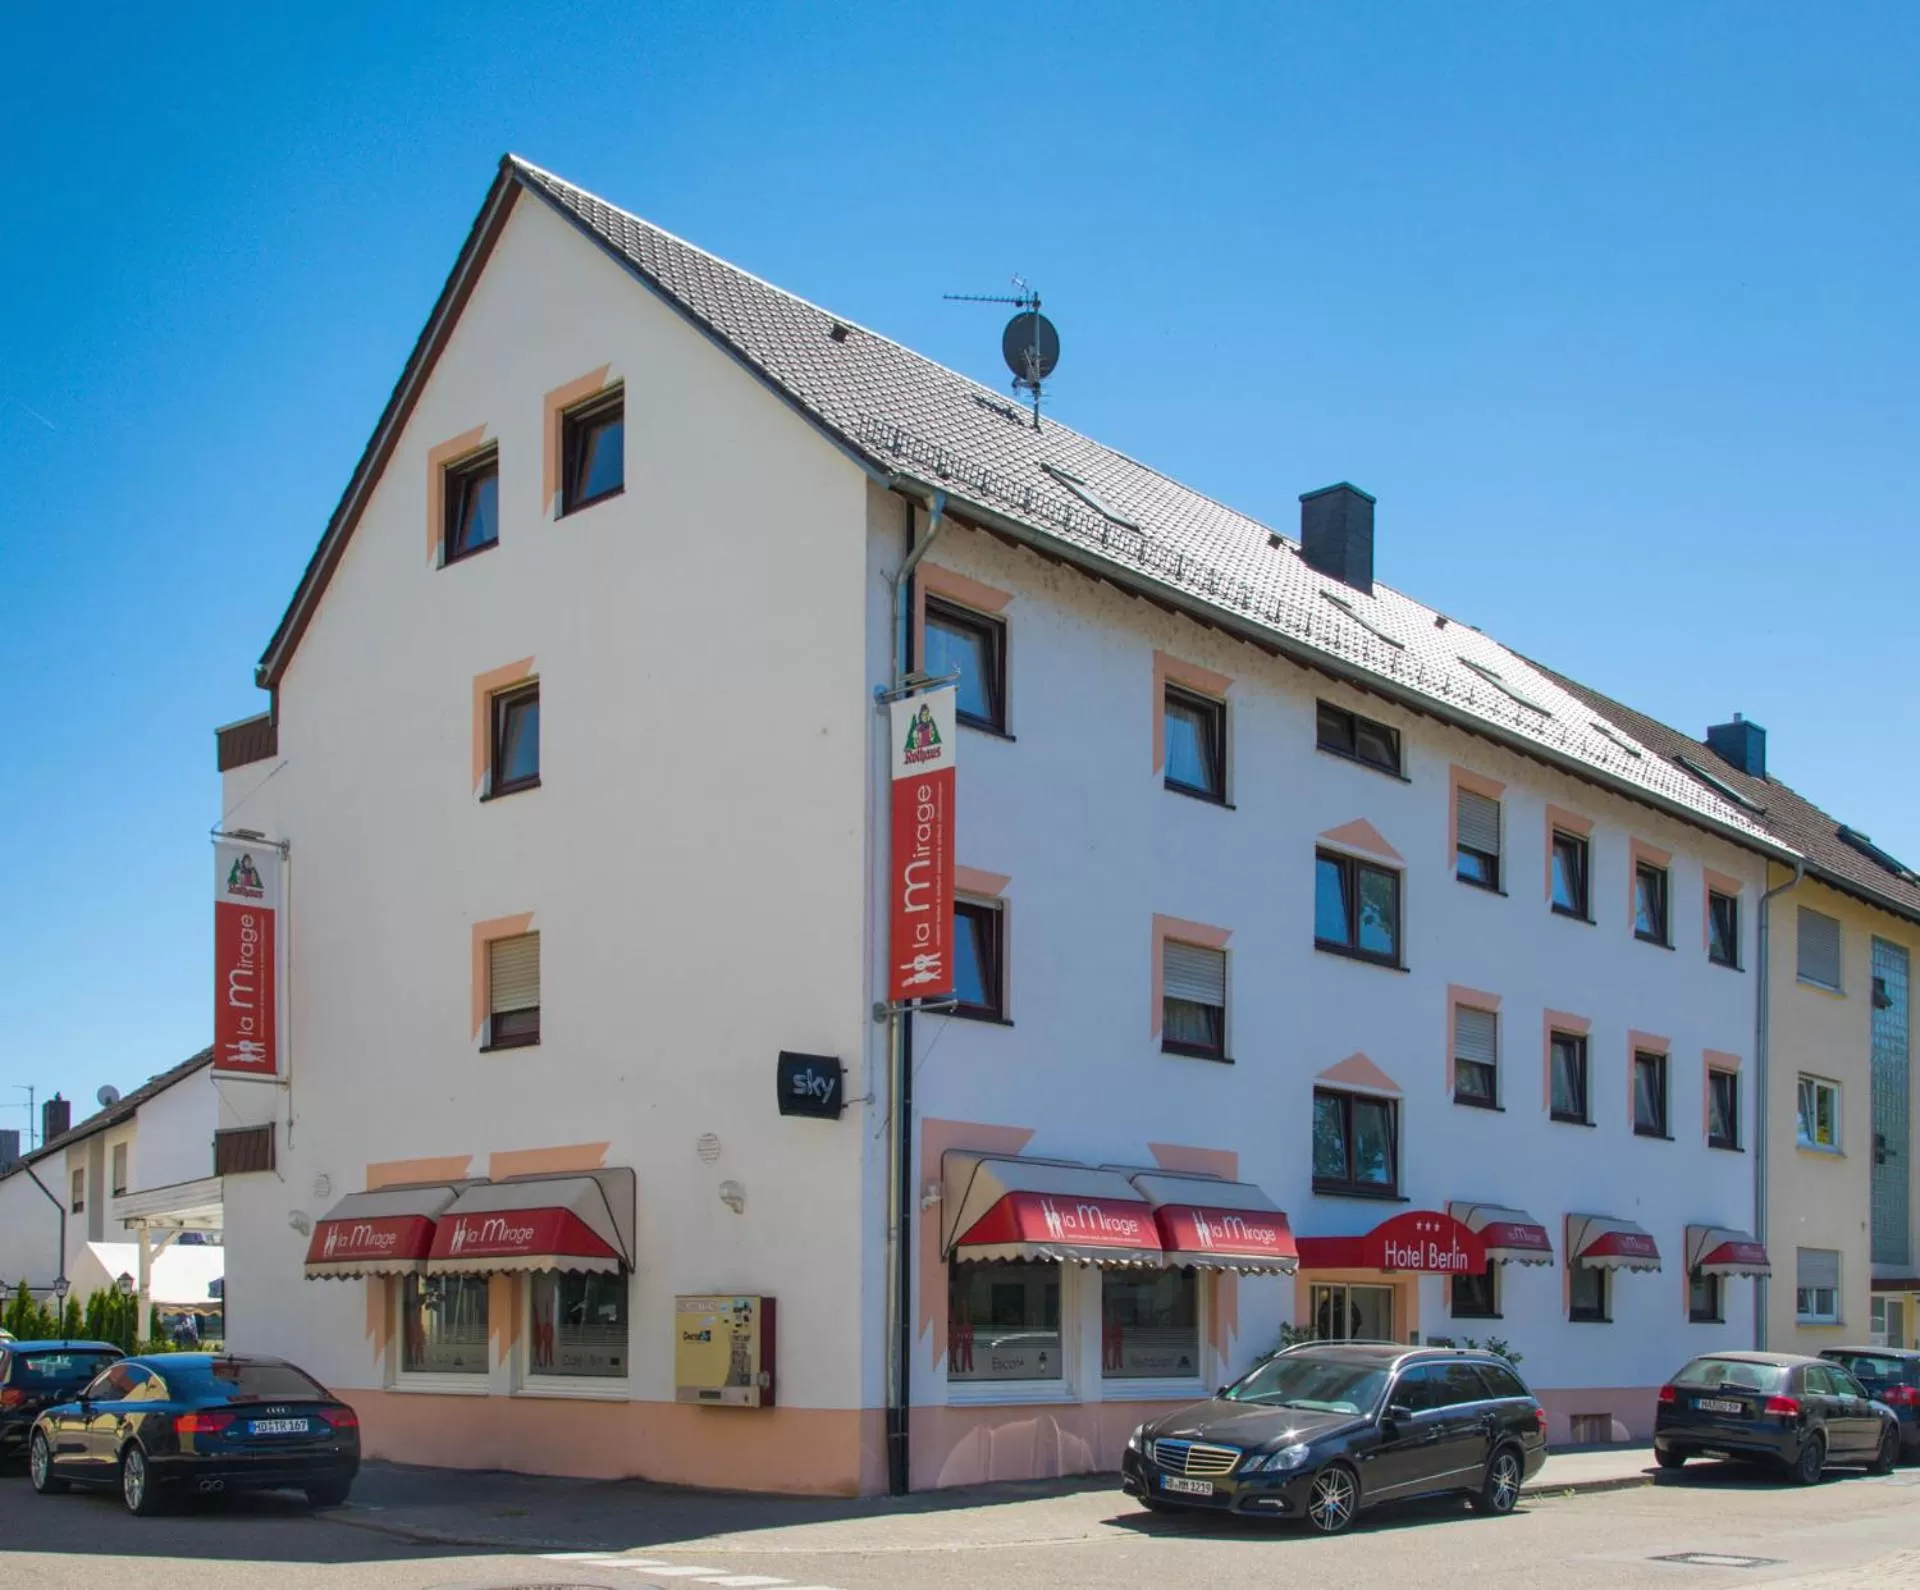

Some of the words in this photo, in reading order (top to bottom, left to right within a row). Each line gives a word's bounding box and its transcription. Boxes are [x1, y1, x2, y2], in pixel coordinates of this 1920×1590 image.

[904, 783, 935, 913] Mirage
[912, 922, 930, 948] la
[227, 913, 259, 1009] Mirage
[236, 1016, 254, 1036] la
[792, 1068, 836, 1105] sky
[466, 1227, 478, 1243] la
[479, 1218, 534, 1244] Mirage
[1061, 1210, 1076, 1228] la
[1077, 1204, 1138, 1236] Mirage
[1209, 1221, 1222, 1238] la
[1222, 1215, 1276, 1245] Mirage
[337, 1232, 348, 1249] la
[349, 1224, 397, 1249] Mirage
[1384, 1239, 1424, 1268] Hotel
[1429, 1231, 1468, 1270] Berlin
